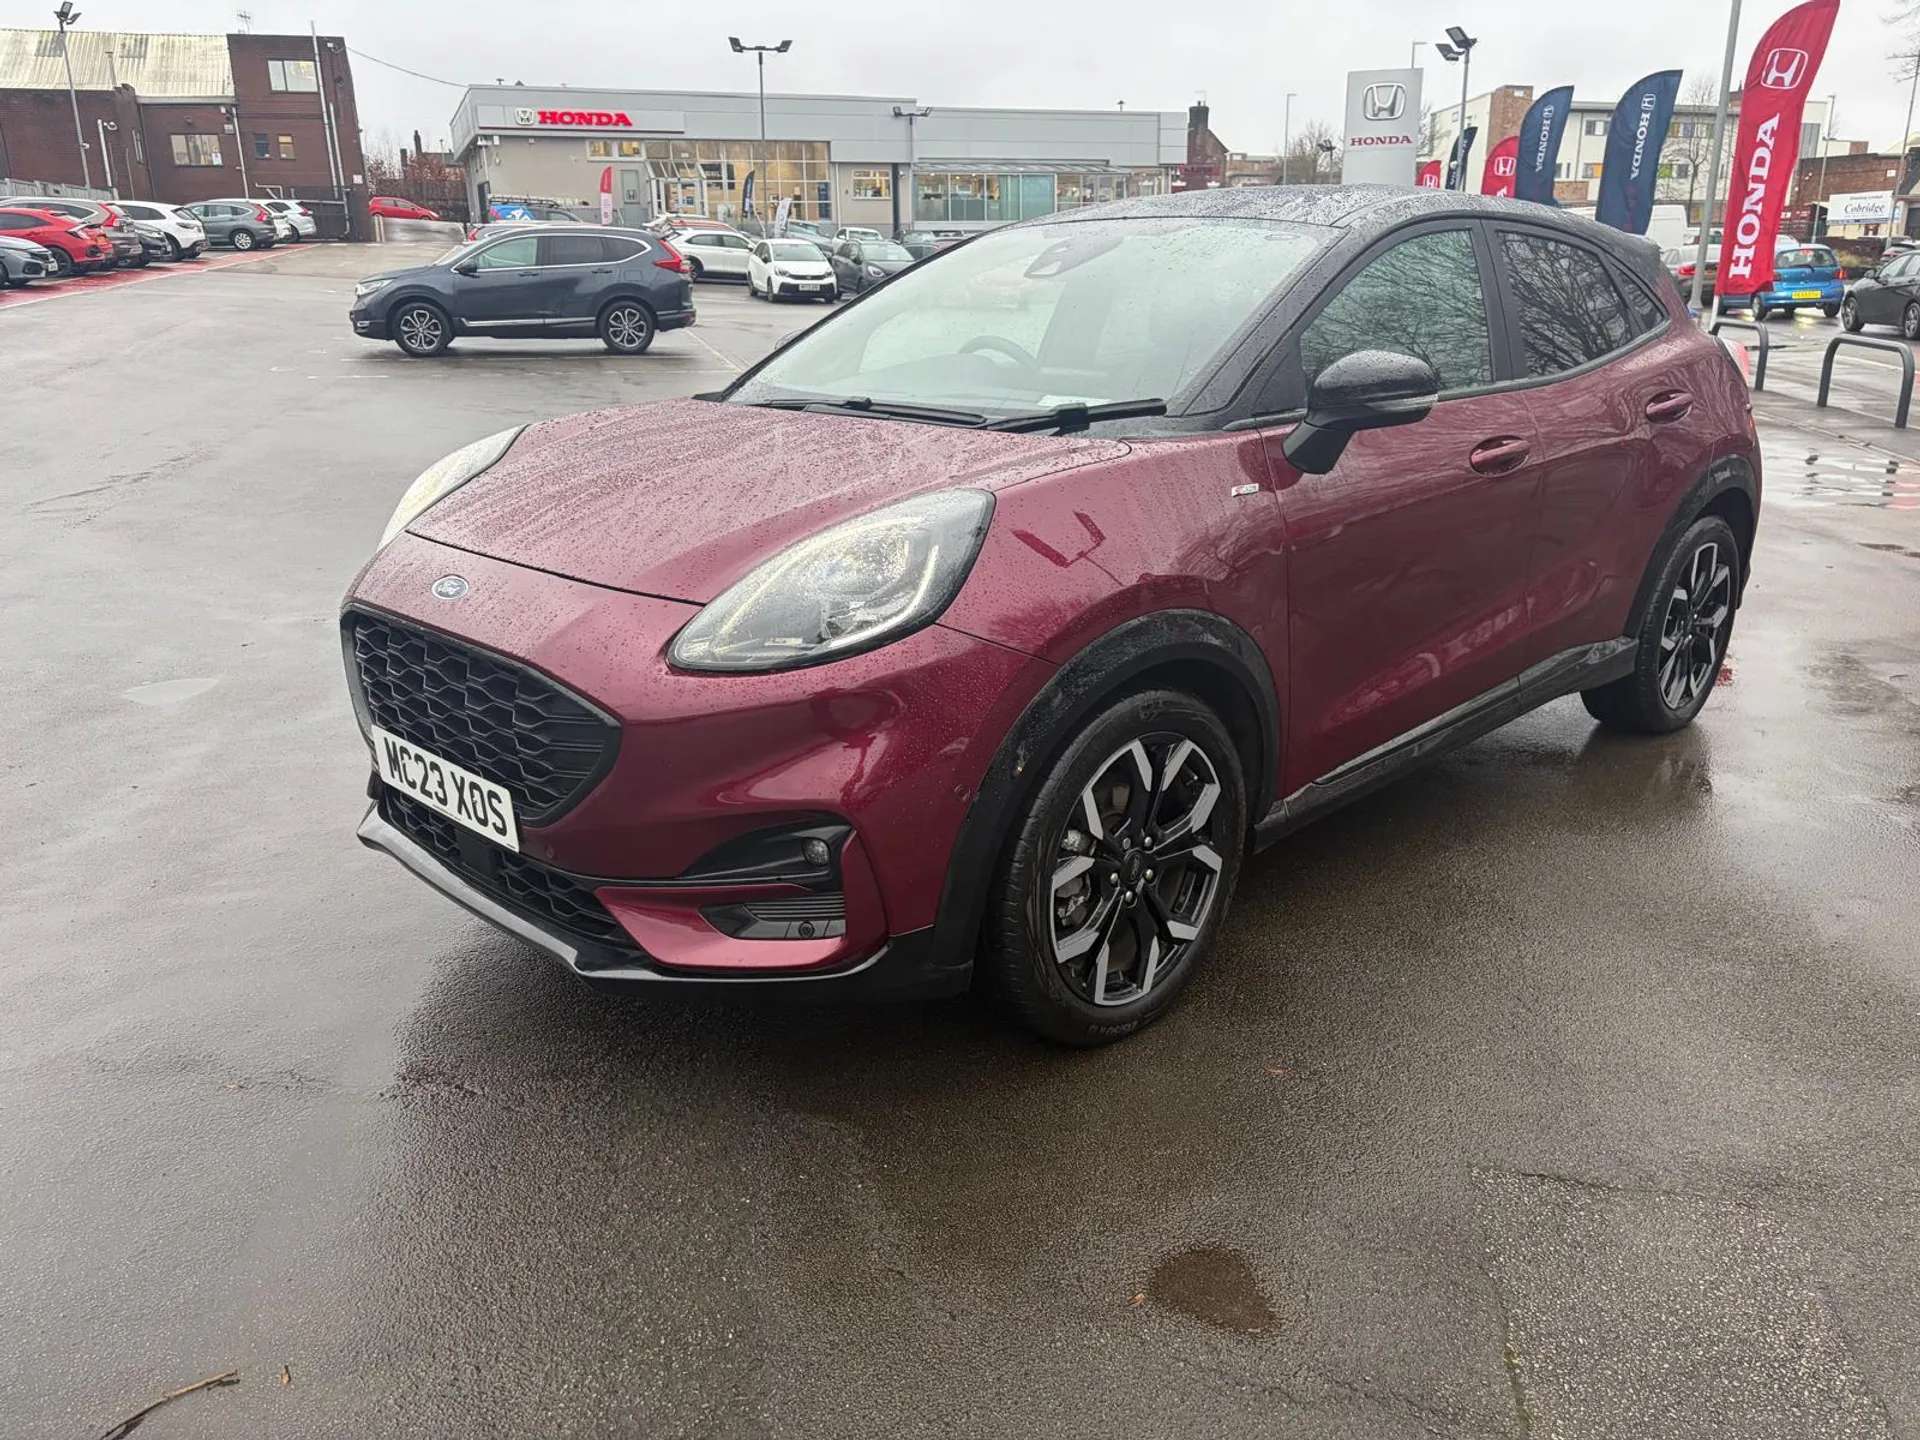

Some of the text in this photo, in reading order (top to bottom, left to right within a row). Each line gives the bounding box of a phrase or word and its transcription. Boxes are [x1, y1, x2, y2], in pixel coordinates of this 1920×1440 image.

[537, 110, 633, 127] HONDA
[1349, 135, 1414, 146] HONDA
[1535, 118, 1555, 172] HONDA
[1630, 112, 1651, 180] HONDA
[1728, 112, 1780, 279] HONDA
[384, 737, 508, 837] MC23 XOS
